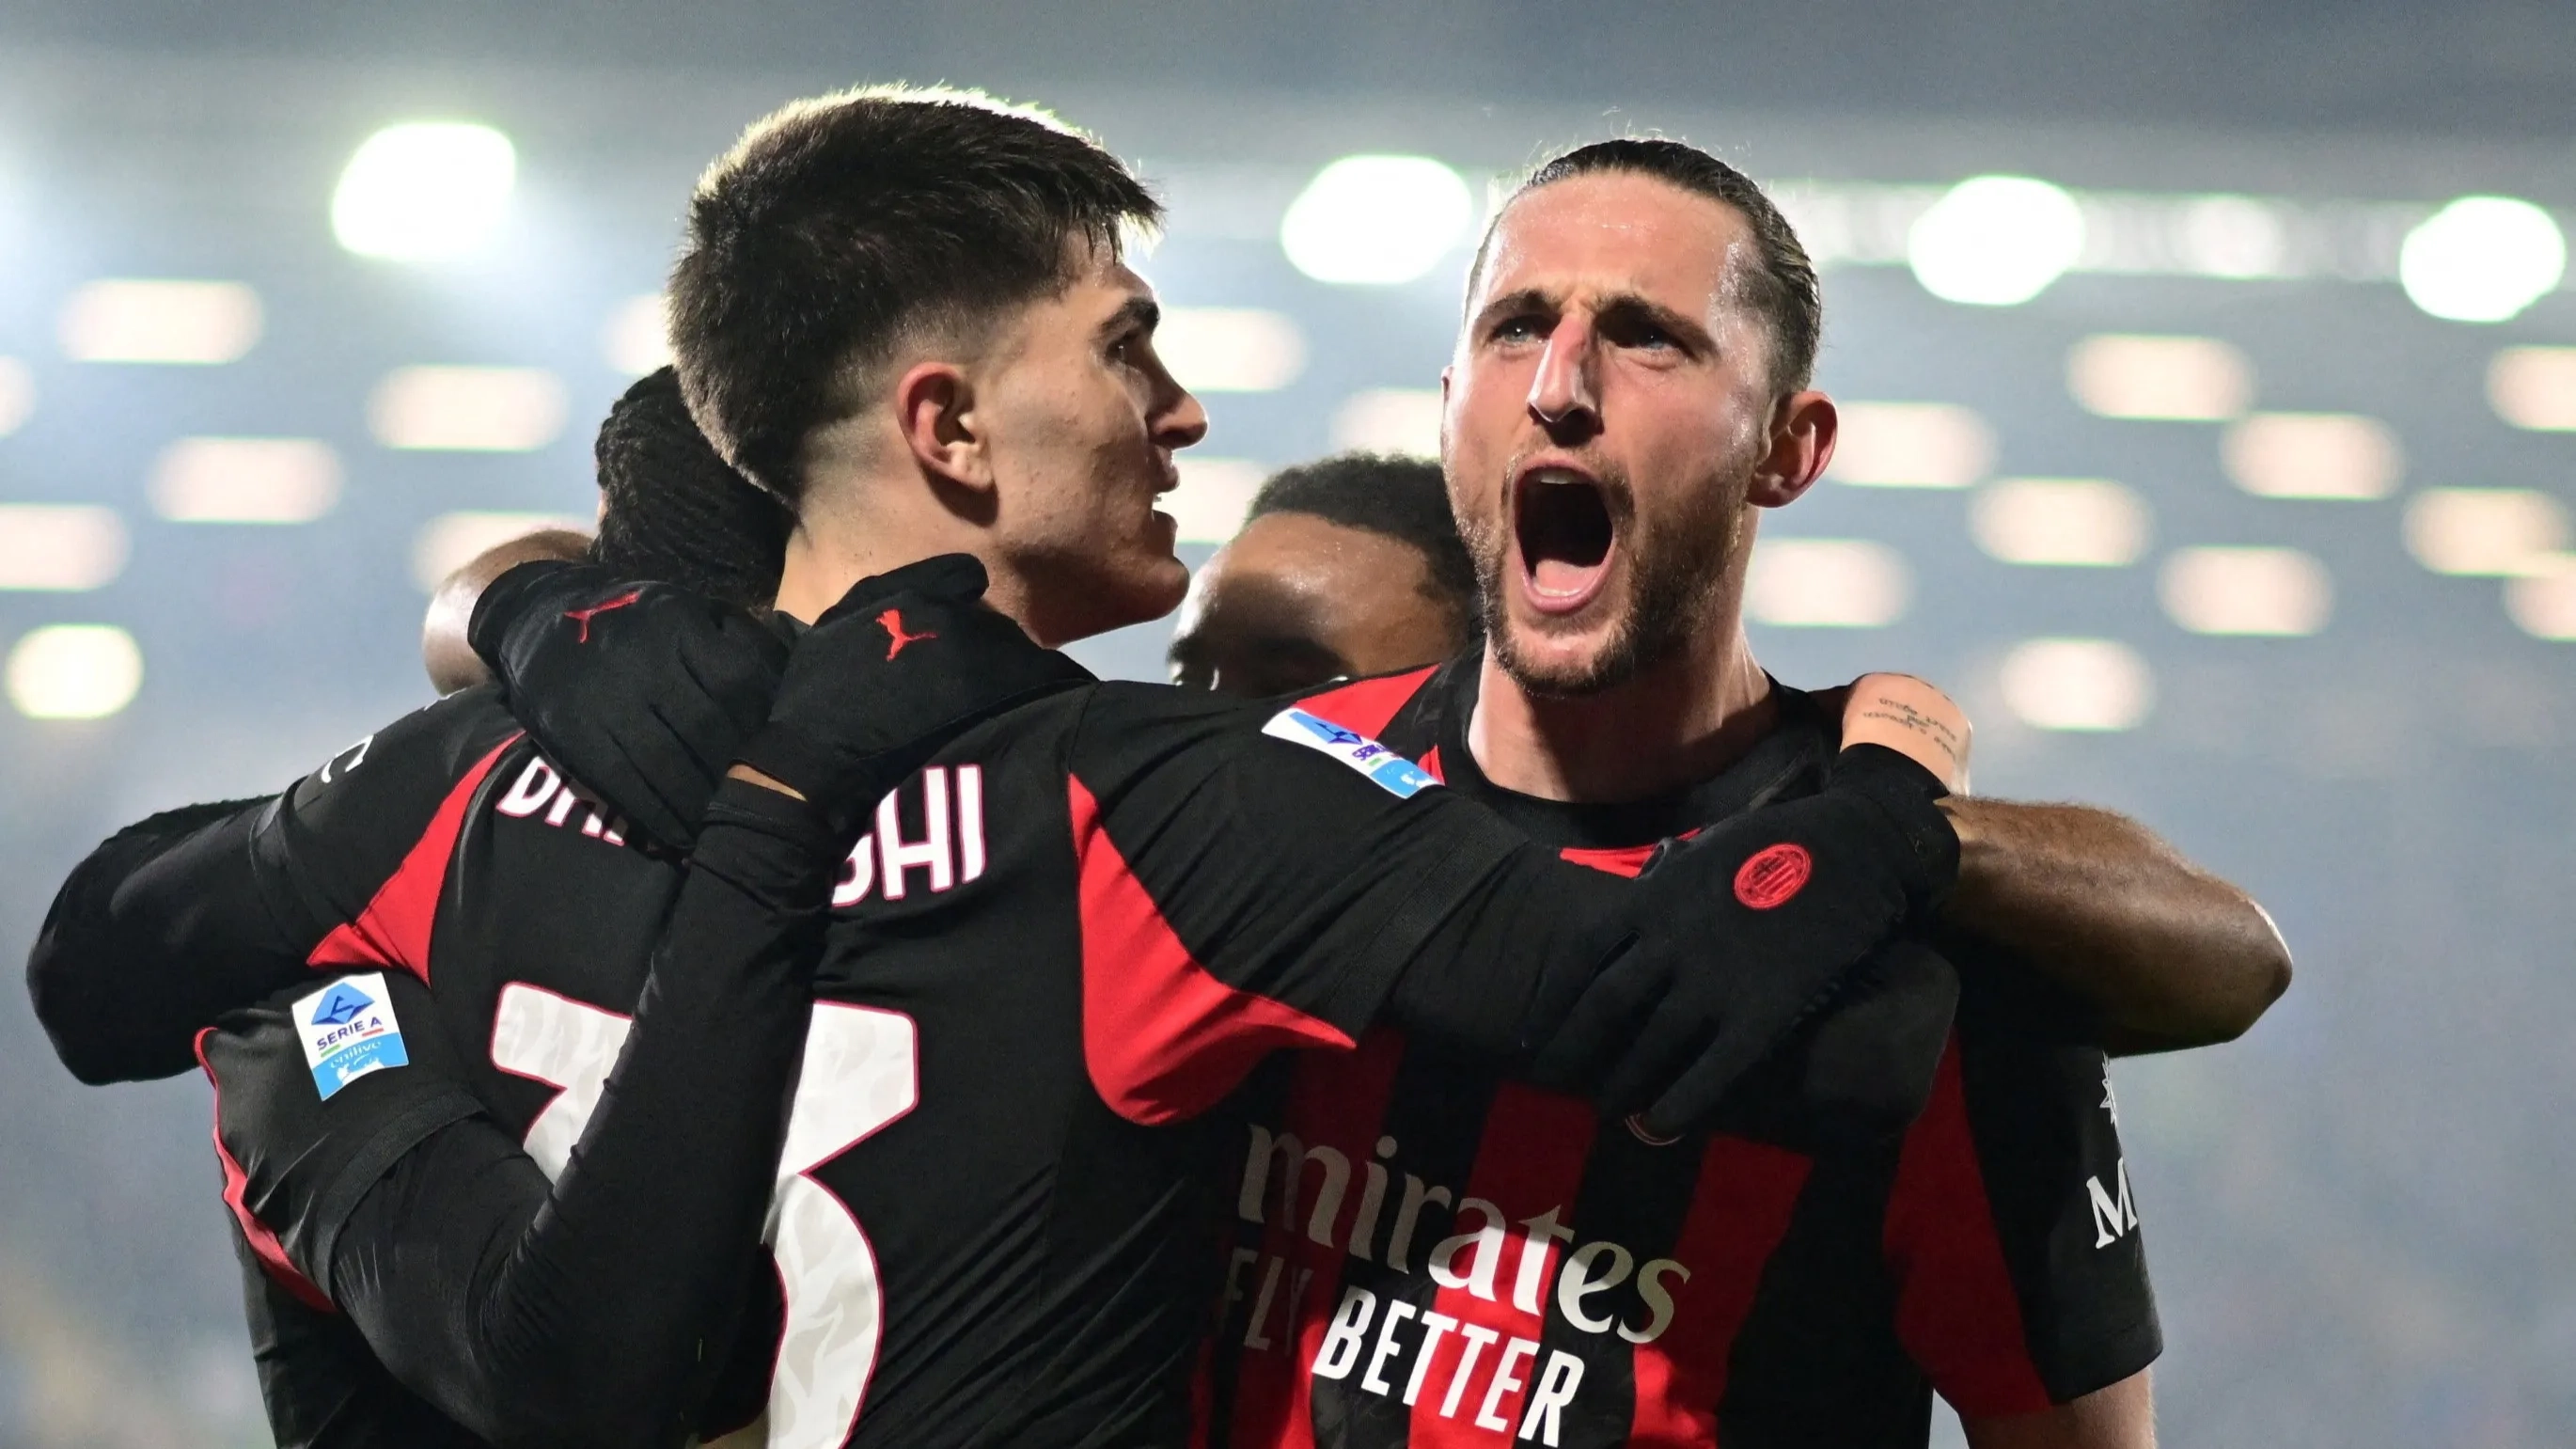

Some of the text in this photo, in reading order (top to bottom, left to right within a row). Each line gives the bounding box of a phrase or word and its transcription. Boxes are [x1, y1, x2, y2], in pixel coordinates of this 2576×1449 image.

[316, 1016, 383, 1051] SERIE A
[1237, 1124, 1691, 1345] mirates
[2085, 1157, 2139, 1250] M
[1311, 1284, 1586, 1449] BETTER
